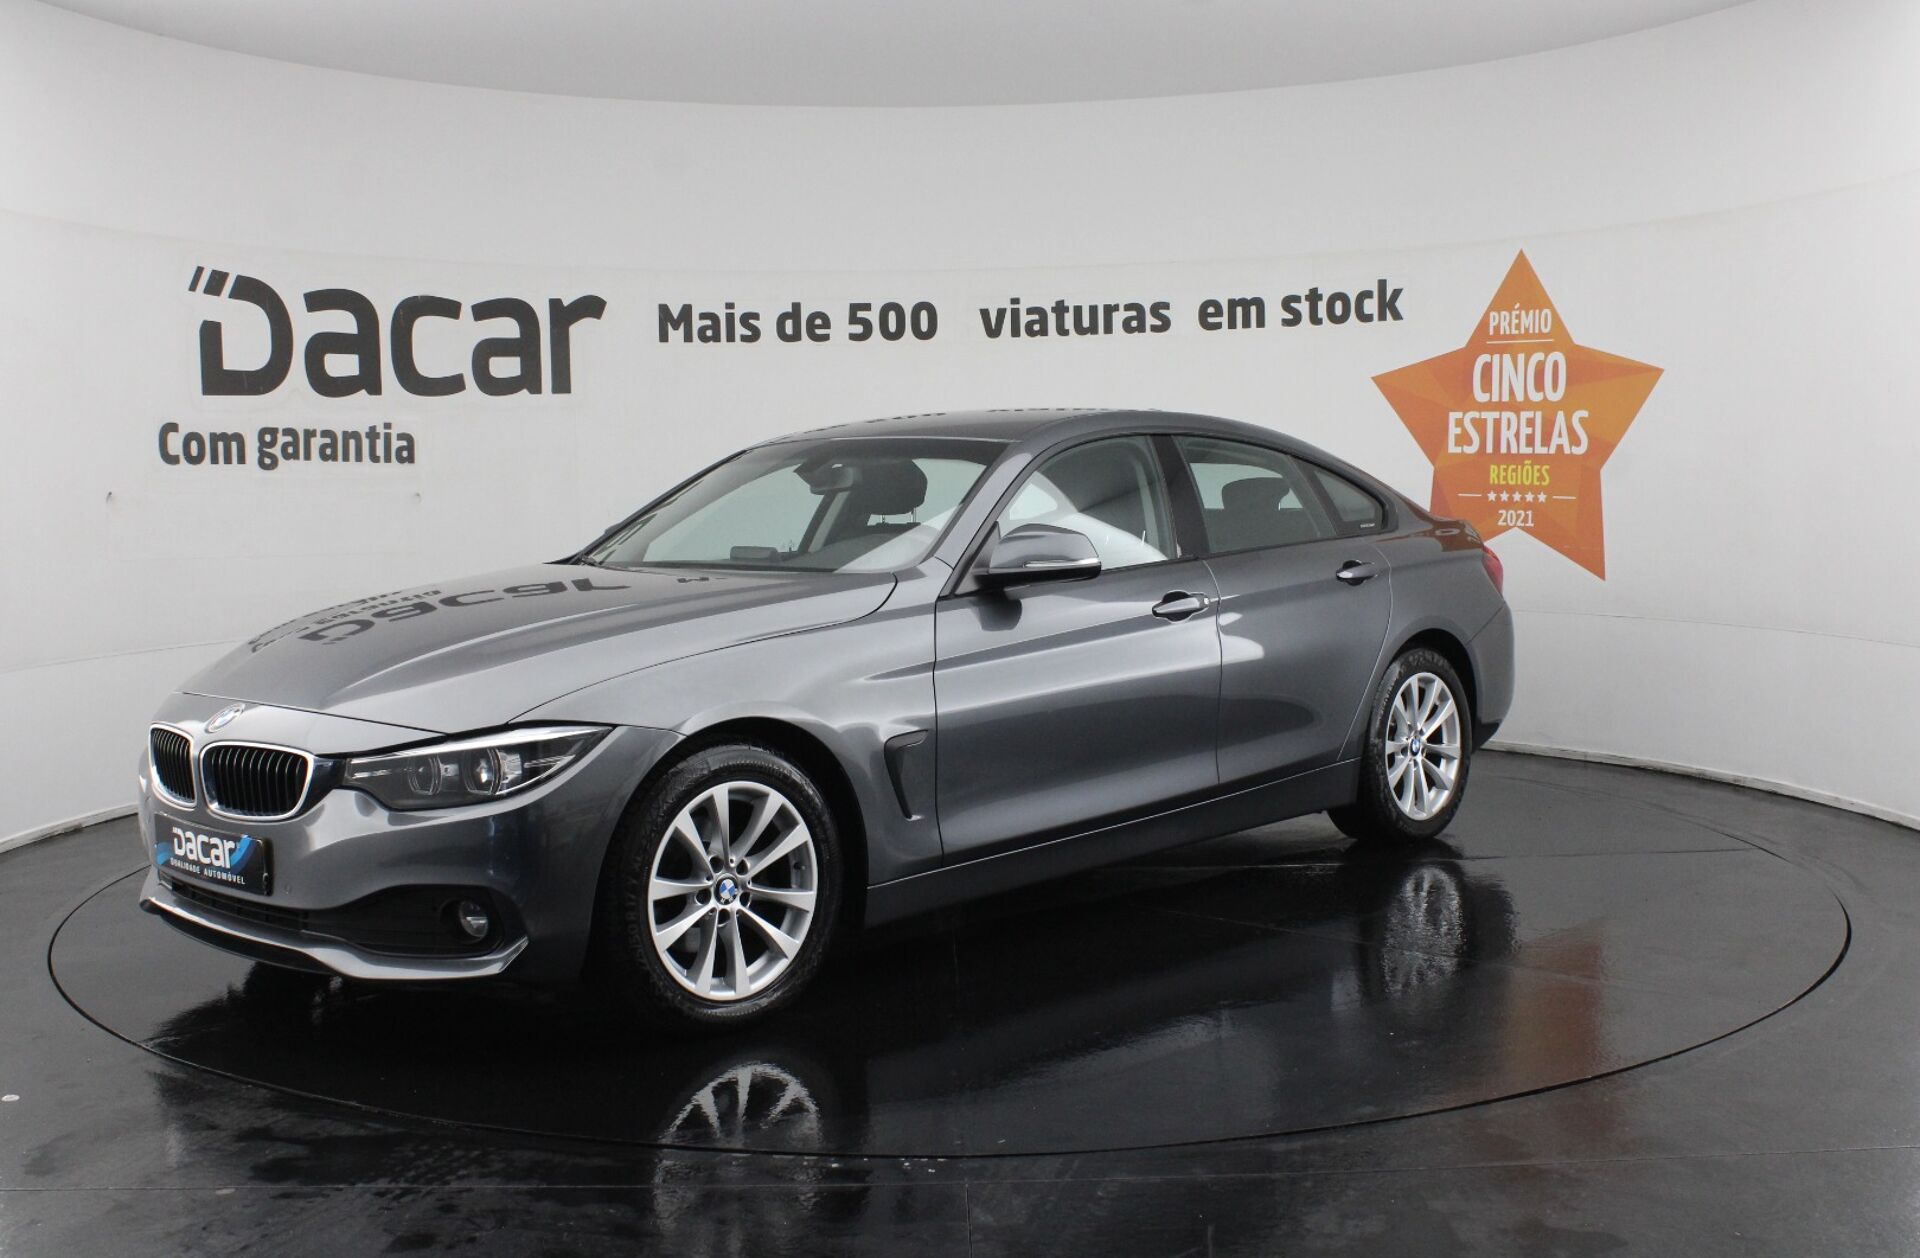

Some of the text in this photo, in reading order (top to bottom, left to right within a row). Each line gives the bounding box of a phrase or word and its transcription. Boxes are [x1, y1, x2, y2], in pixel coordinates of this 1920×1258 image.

[188, 266, 607, 398] Dacar
[658, 279, 1404, 343] Mais de 500 viaturas em stock
[1489, 303, 1552, 335] PRÉMIO
[1472, 351, 1567, 403] CINCO
[158, 422, 415, 471] Com garantia
[1447, 410, 1589, 455] ESTRELAS
[1489, 460, 1550, 486] REGIÕES
[1497, 510, 1534, 527] 2021
[172, 826, 236, 869] Dacar
[203, 868, 246, 885] AUTOMÓVEL
